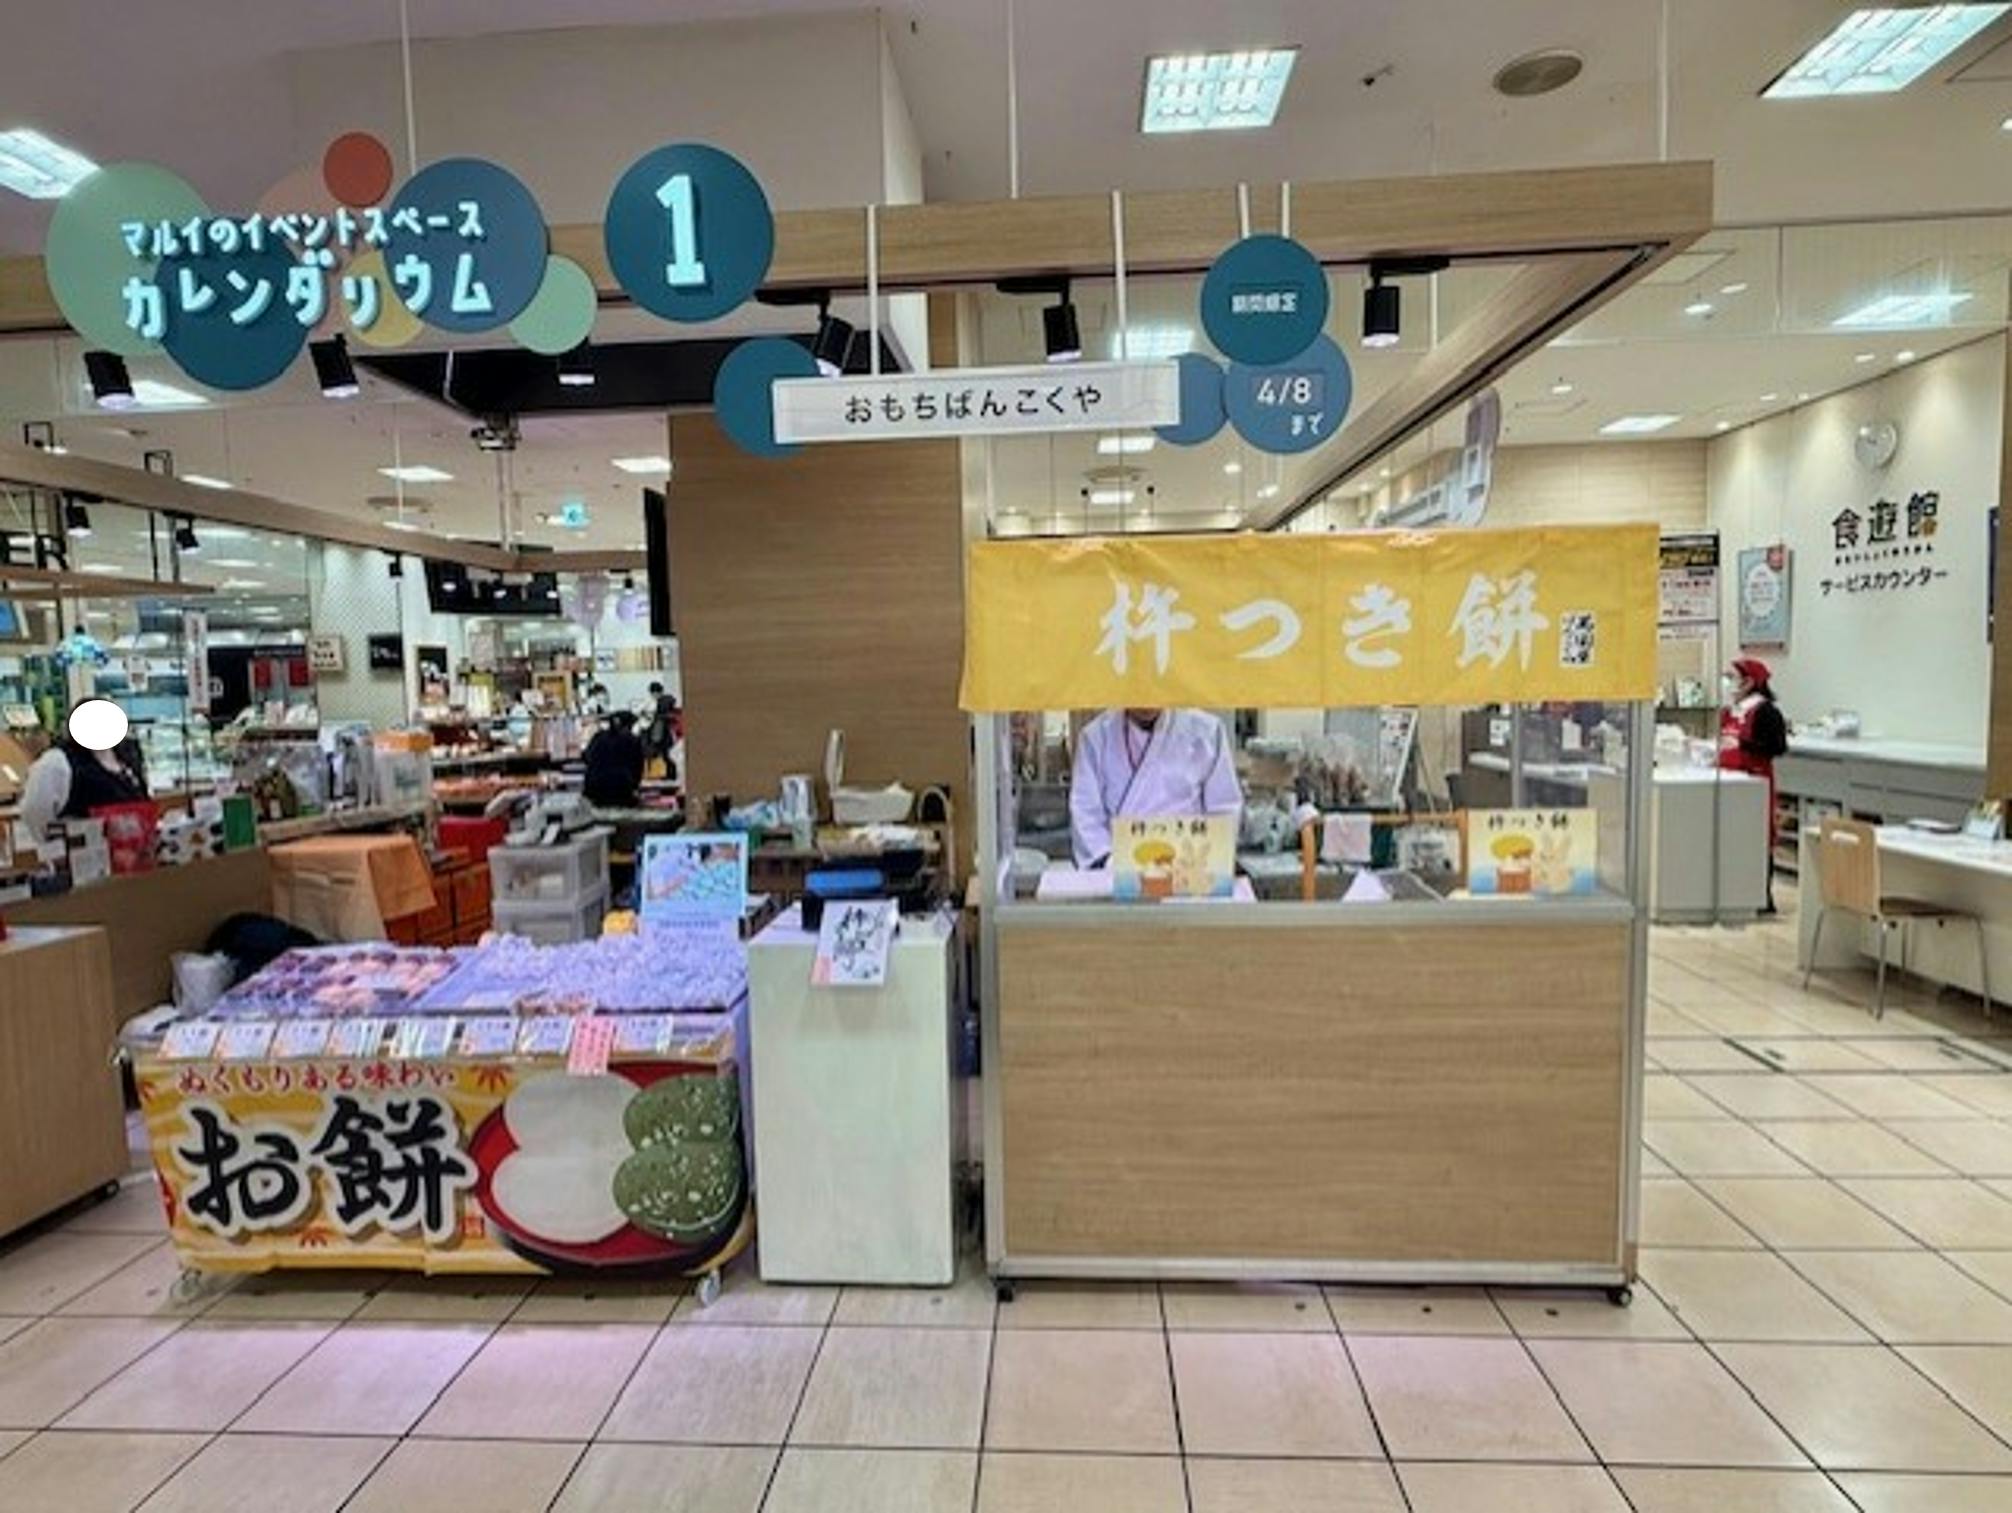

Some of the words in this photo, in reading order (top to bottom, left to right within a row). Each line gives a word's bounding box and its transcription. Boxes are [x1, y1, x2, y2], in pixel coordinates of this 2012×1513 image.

[121, 202, 484, 256] マルイのイベントスペース
[656, 174, 708, 288] 1
[122, 249, 493, 339] カレンダリウム
[1257, 376, 1312, 405] 4/8
[1831, 490, 1939, 549] 食遊館
[1820, 566, 1947, 596] サービスカウンター
[1093, 569, 1550, 677] 杵つき餅
[179, 1060, 455, 1095] ぬくもりある味わい
[177, 1097, 467, 1231] お餅
